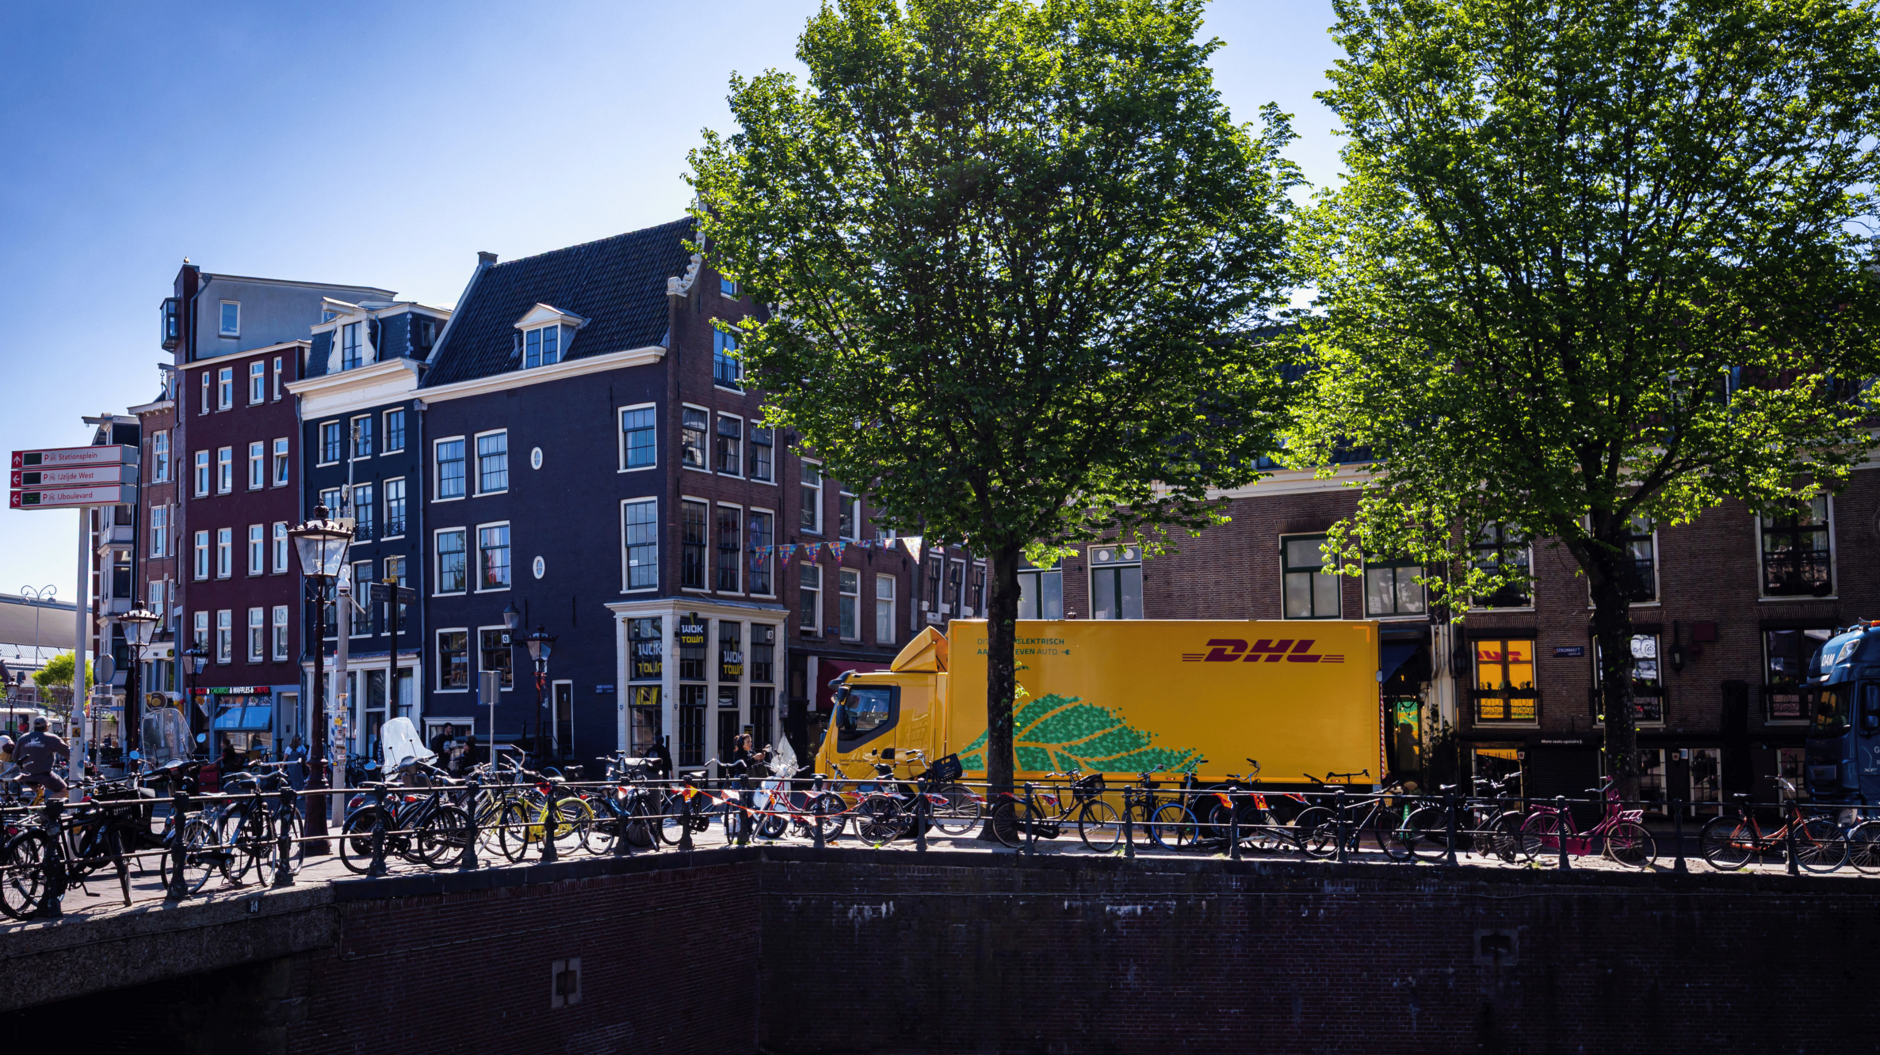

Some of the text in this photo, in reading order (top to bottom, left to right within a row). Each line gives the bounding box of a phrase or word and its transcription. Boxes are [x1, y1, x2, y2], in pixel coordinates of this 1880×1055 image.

[58, 452, 98, 461] Stationsplein
[58, 473, 77, 481] IJzijde
[57, 491, 93, 500] IJboulevard
[681, 624, 704, 633] WOK
[681, 635, 704, 643] TOWN
[1204, 639, 1323, 663] DHL
[723, 650, 743, 662] WOK
[723, 664, 743, 675] TOWN
